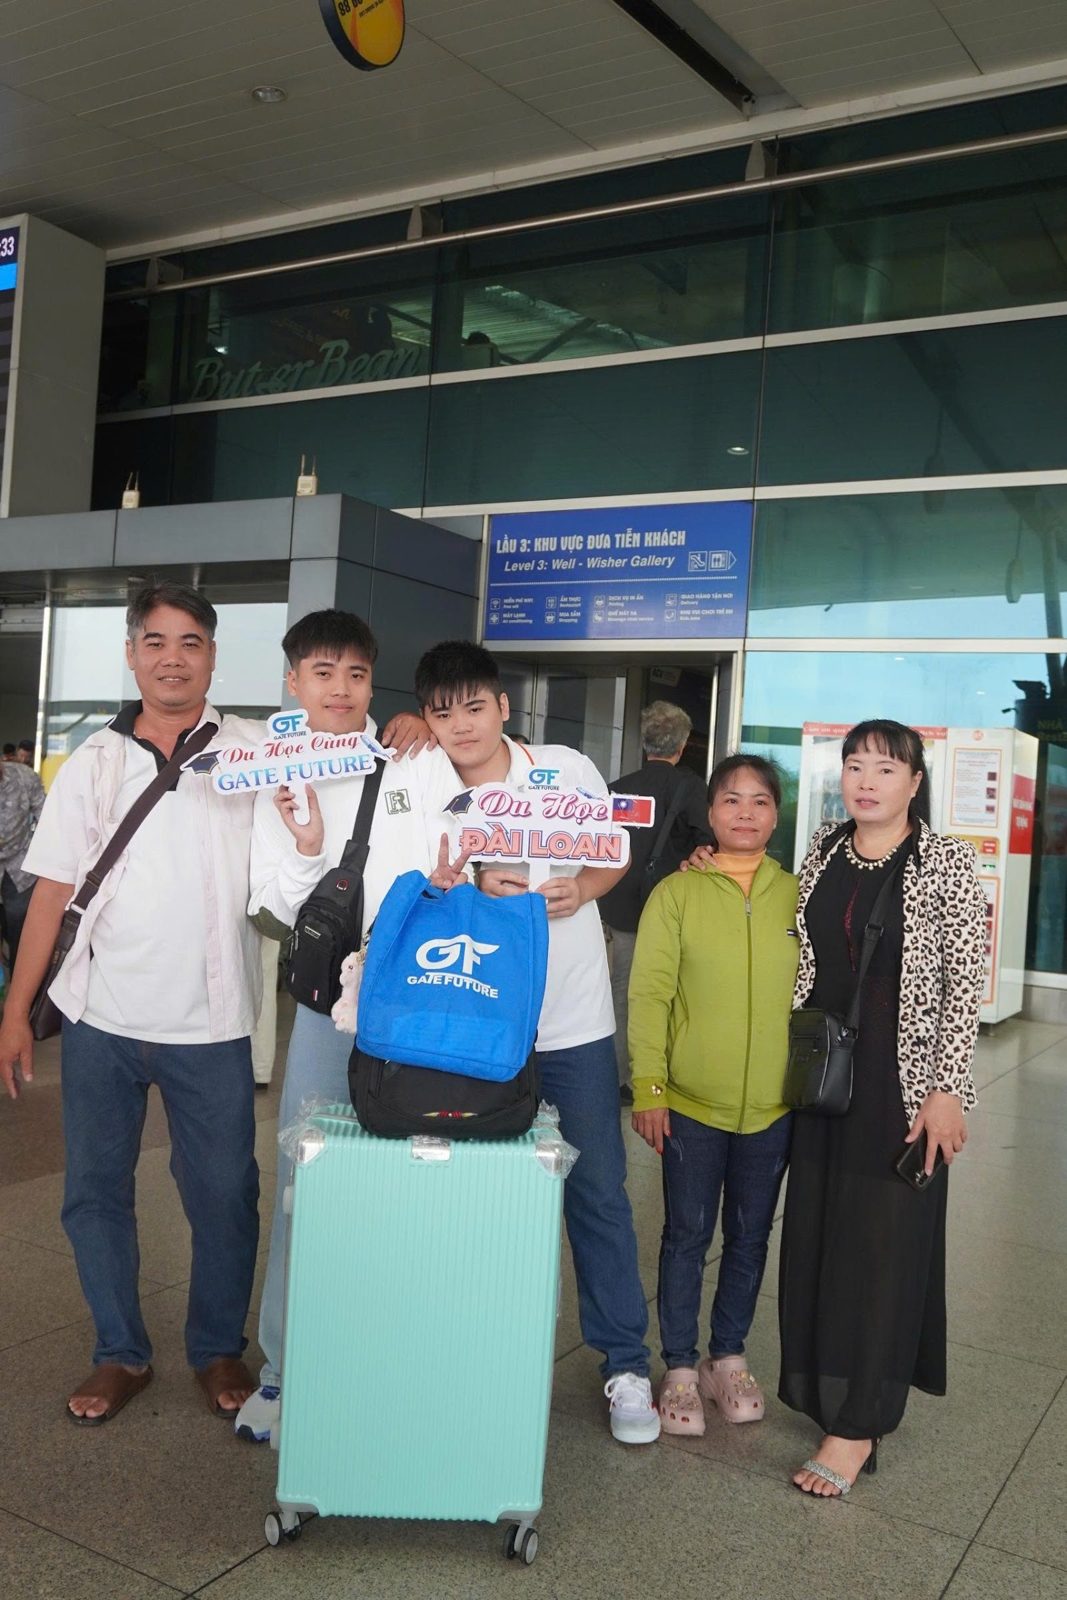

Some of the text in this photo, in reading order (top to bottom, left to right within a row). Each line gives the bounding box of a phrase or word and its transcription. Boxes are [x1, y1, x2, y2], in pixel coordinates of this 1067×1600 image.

[313, 338, 422, 386] Bean
[496, 528, 686, 554] LẦU 3: KHU VỰC ĐƯA TIỄN KHÁCH
[504, 559, 535, 572] Level
[537, 559, 548, 571] 3:
[552, 558, 577, 570] Well
[587, 556, 628, 569] Wisher
[630, 554, 676, 569] Gallery
[272, 714, 304, 733] GF
[223, 735, 360, 763] Du Học Cùng
[218, 754, 372, 791] GATE FUTURE
[529, 769, 560, 784] GF
[478, 790, 608, 825] Du Học
[459, 822, 622, 862] ĐÀI LOAN
[416, 934, 500, 975] GF
[407, 972, 499, 999] GATE FUTURE
